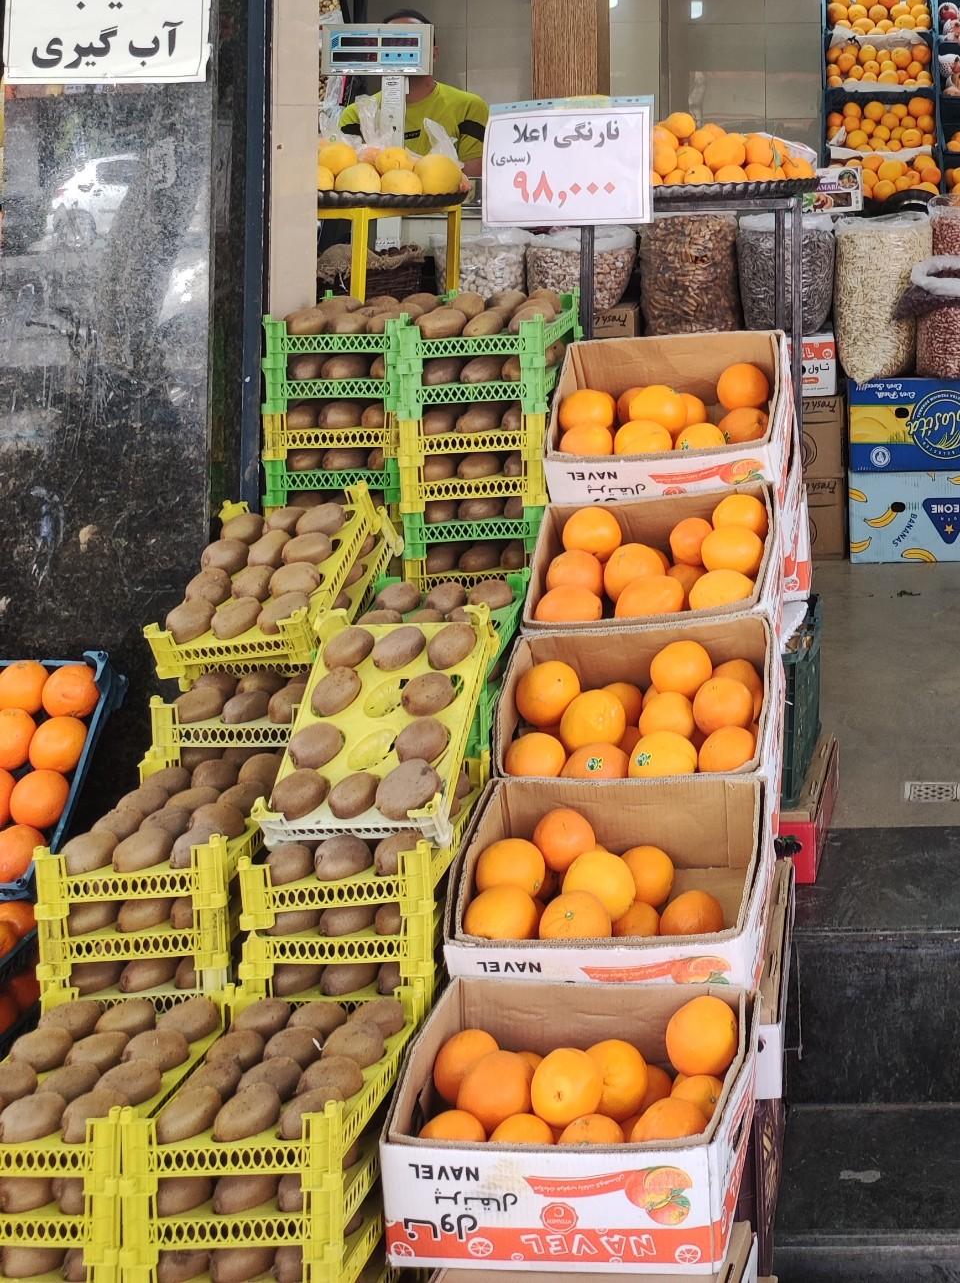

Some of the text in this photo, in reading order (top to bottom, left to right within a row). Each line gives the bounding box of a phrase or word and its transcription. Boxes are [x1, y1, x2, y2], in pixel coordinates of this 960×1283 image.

[32, 21, 183, 68] آب گیری
[513, 120, 620, 148] نارنگی اعلا
[490, 151, 531, 167] (سبدی)
[567, 471, 618, 481] NAVEL
[892, 513, 918, 547] BANANAS
[476, 961, 542, 973] NAVEL
[408, 1163, 480, 1182] NAVEL
[434, 1188, 518, 1212] پرتقال
[403, 1213, 478, 1240] ناول
[520, 1232, 657, 1257] NAVEL
